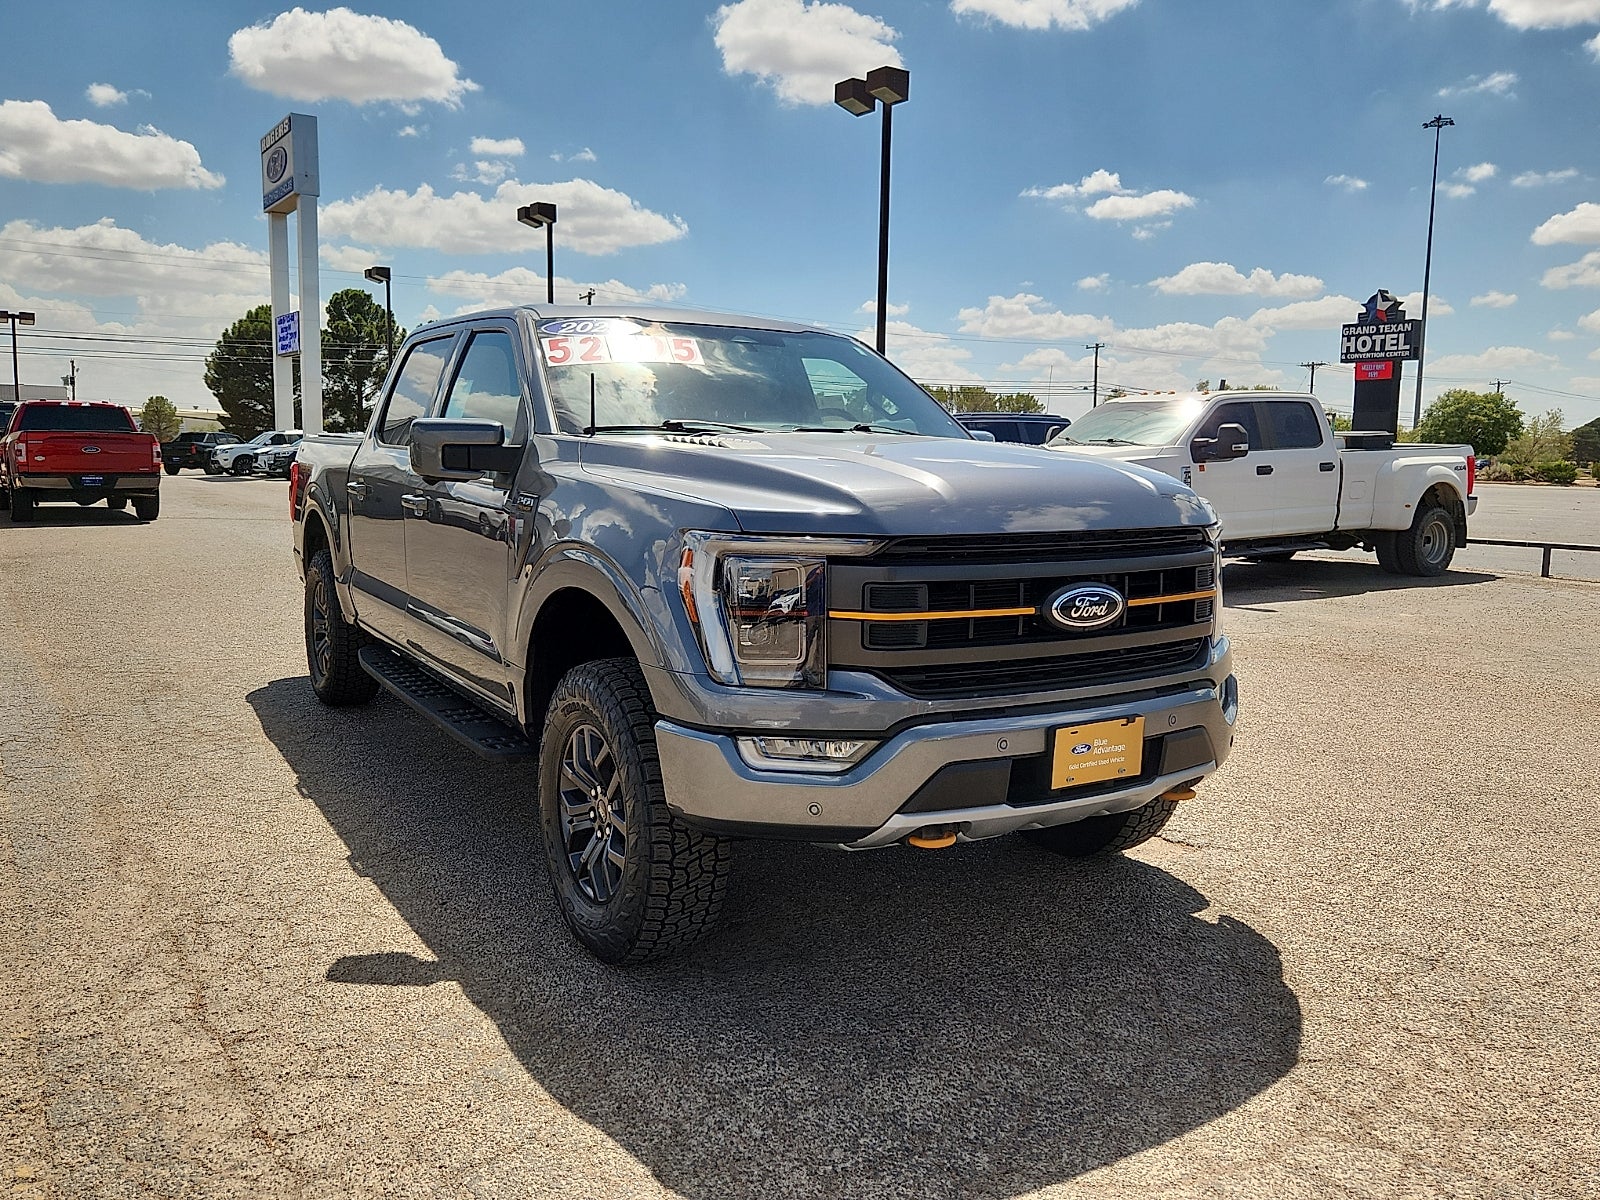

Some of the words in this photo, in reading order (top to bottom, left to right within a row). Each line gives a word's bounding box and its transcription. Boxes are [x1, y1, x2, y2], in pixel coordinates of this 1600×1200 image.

[1343, 325, 1377, 336] GRAND
[1379, 323, 1412, 333] TEXAN
[1341, 333, 1410, 353] HOTEL
[1071, 596, 1109, 618] Ford
[1093, 738, 1108, 747] Blue
[1093, 744, 1126, 755] Advantage
[1080, 760, 1098, 768] Certified
